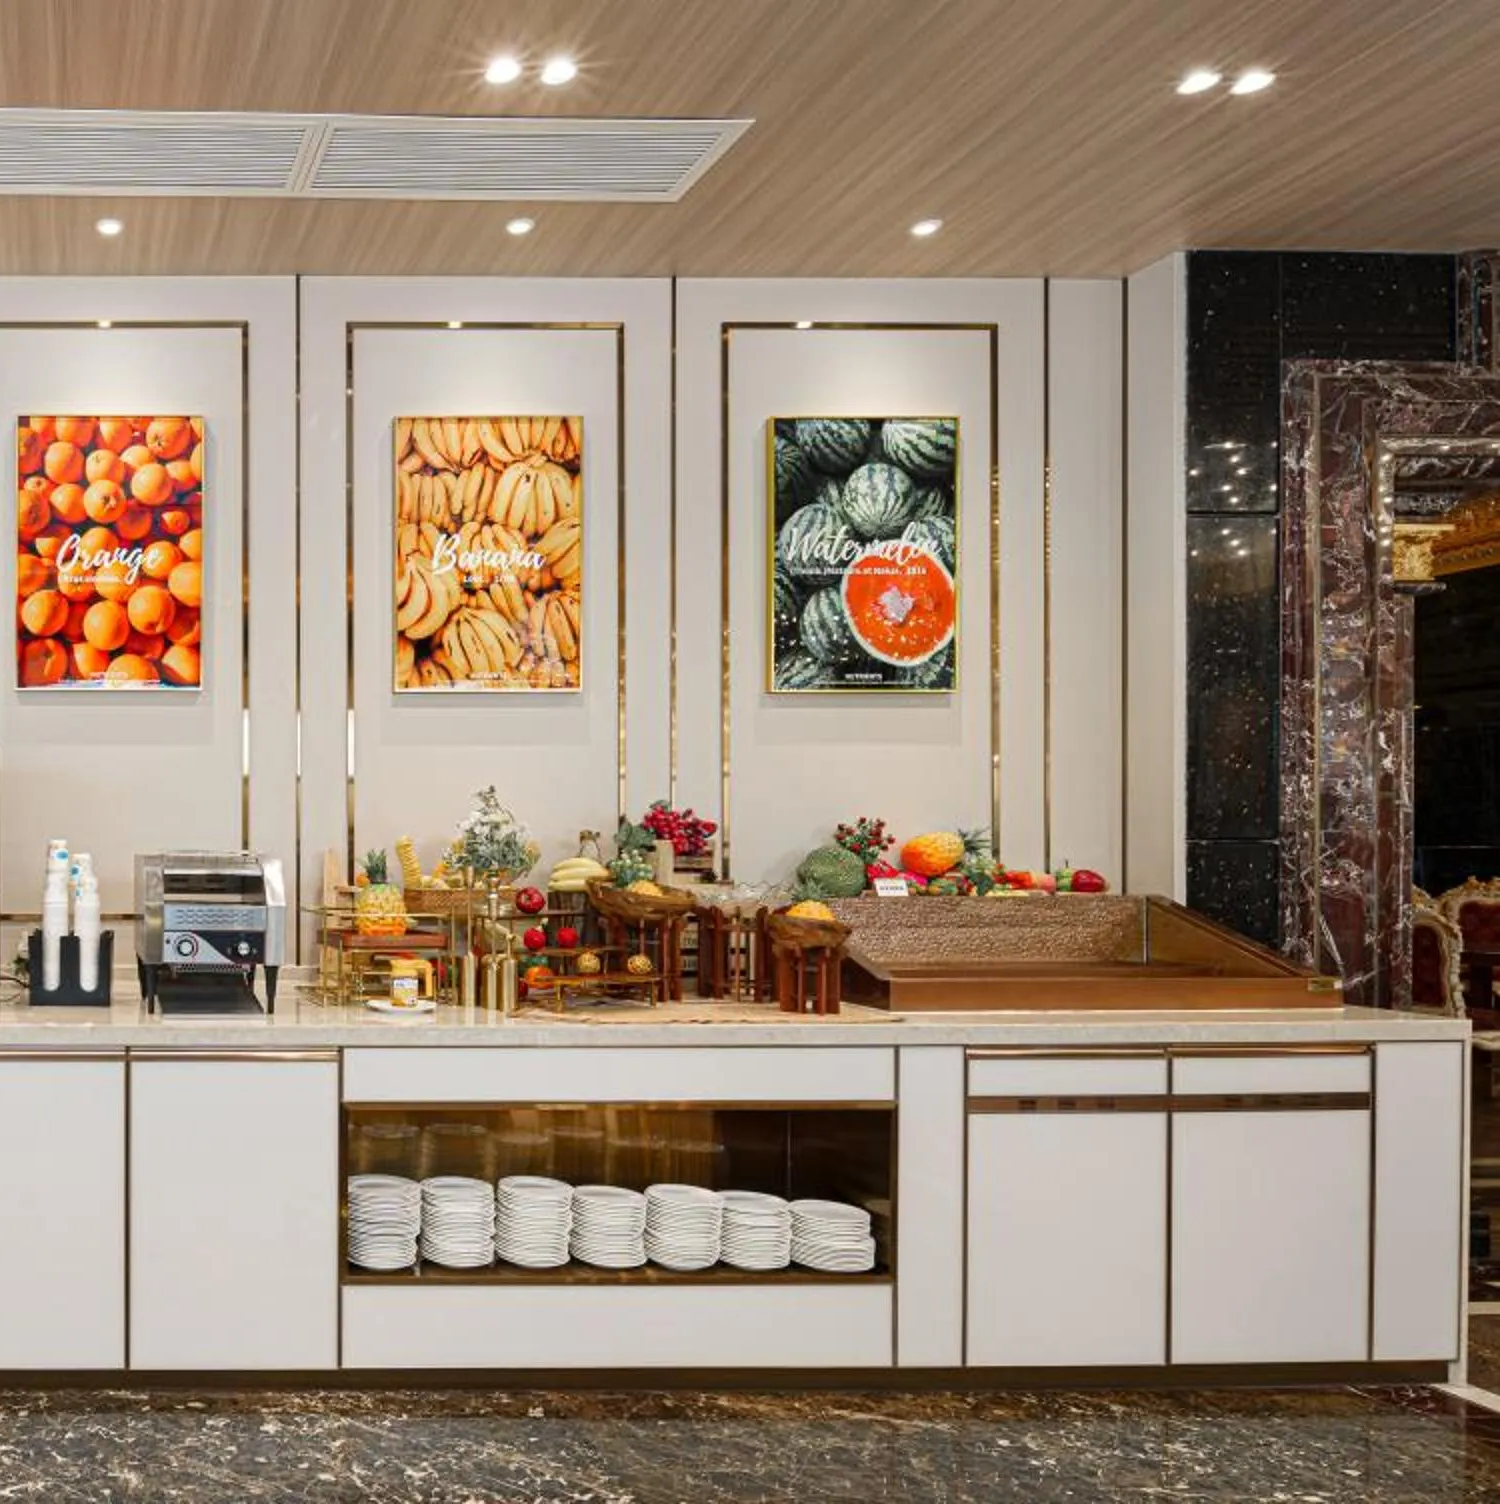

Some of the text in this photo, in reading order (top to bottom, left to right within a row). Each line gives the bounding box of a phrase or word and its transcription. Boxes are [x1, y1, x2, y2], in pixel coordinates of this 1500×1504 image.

[56, 533, 164, 585] Orange
[432, 533, 545, 576] Banana
[787, 521, 942, 565] Watermelon
